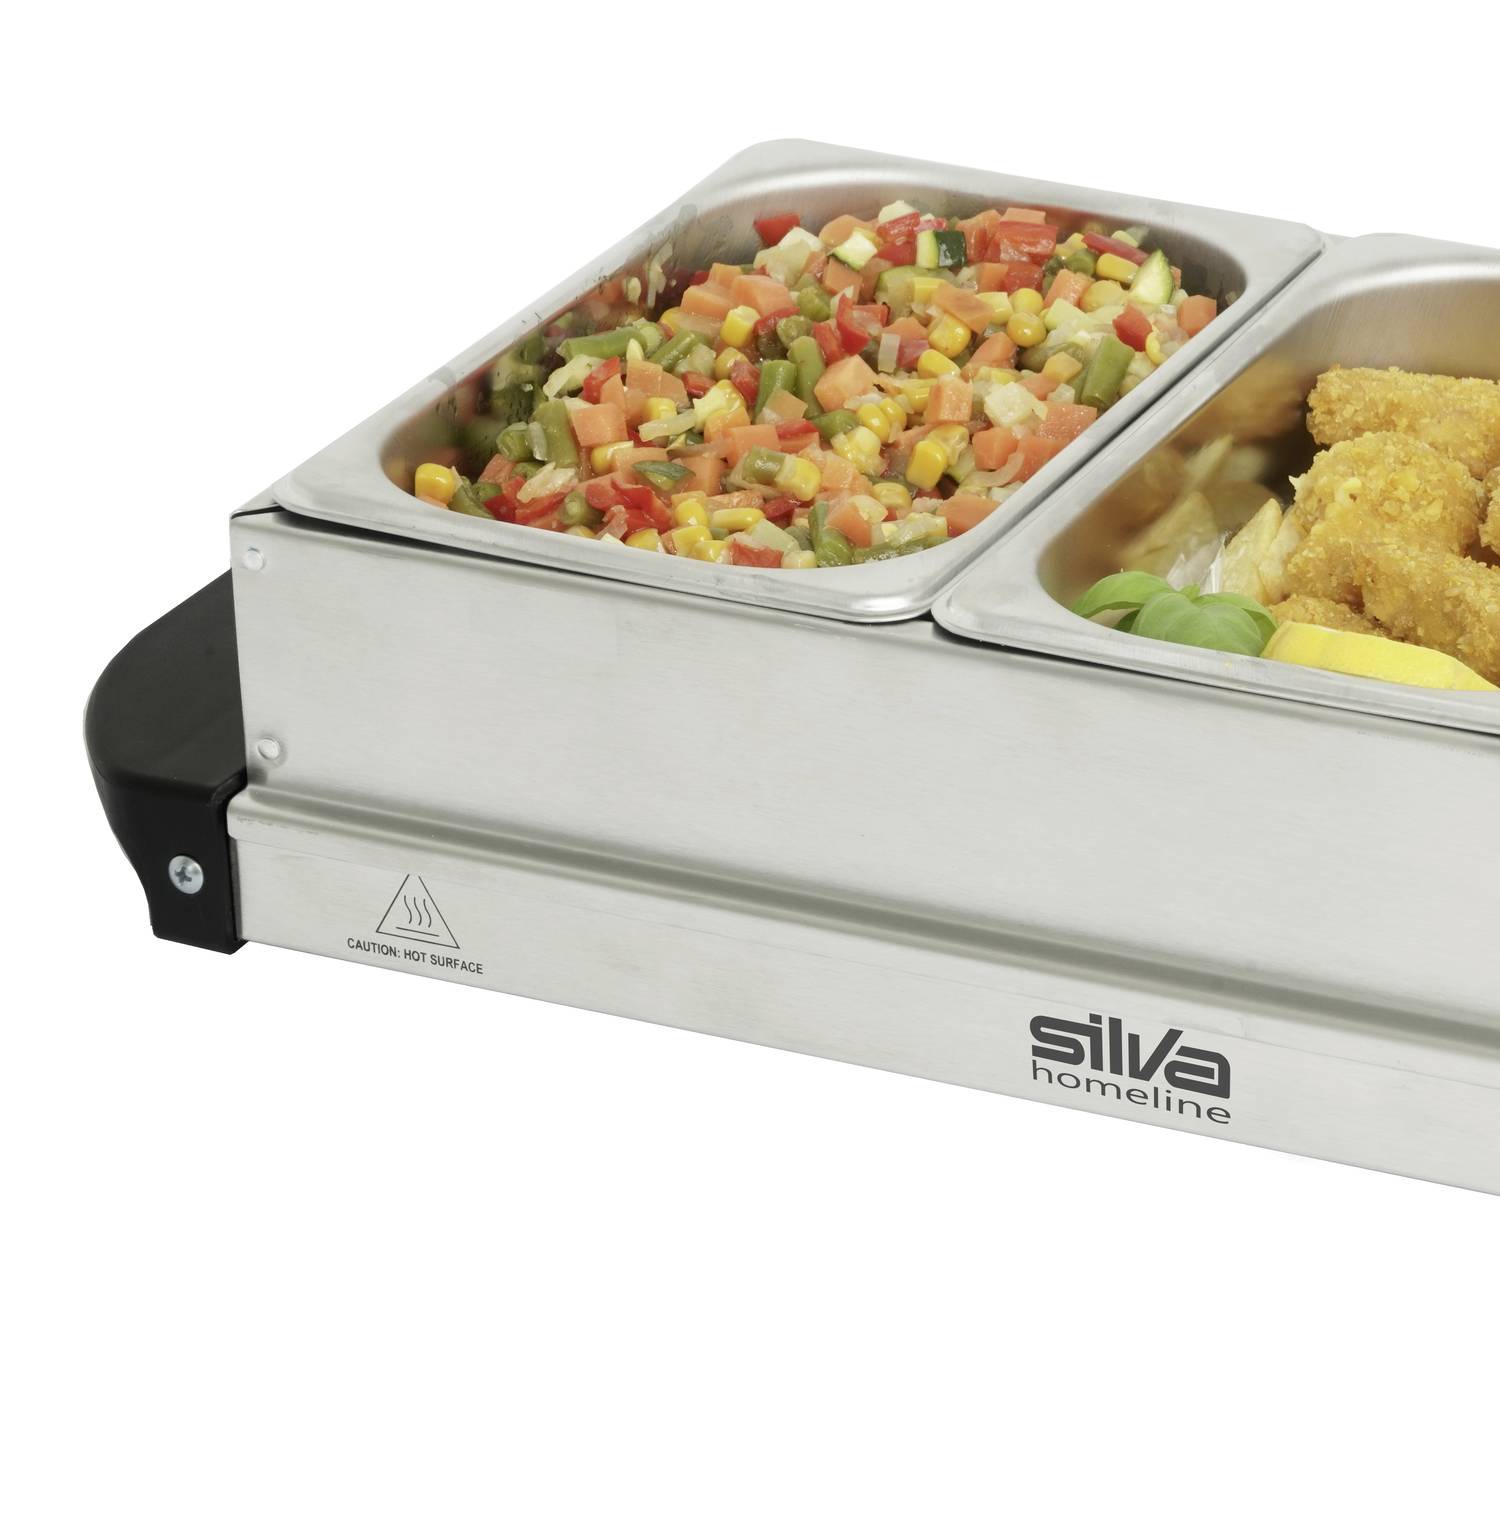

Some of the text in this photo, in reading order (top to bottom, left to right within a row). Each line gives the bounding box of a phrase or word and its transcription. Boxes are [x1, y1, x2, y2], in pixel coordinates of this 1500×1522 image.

[347, 937, 484, 975] CAUTION: HOT SURFACE
[1029, 1012, 1231, 1100] silva
[1032, 1059, 1232, 1125] homeline
